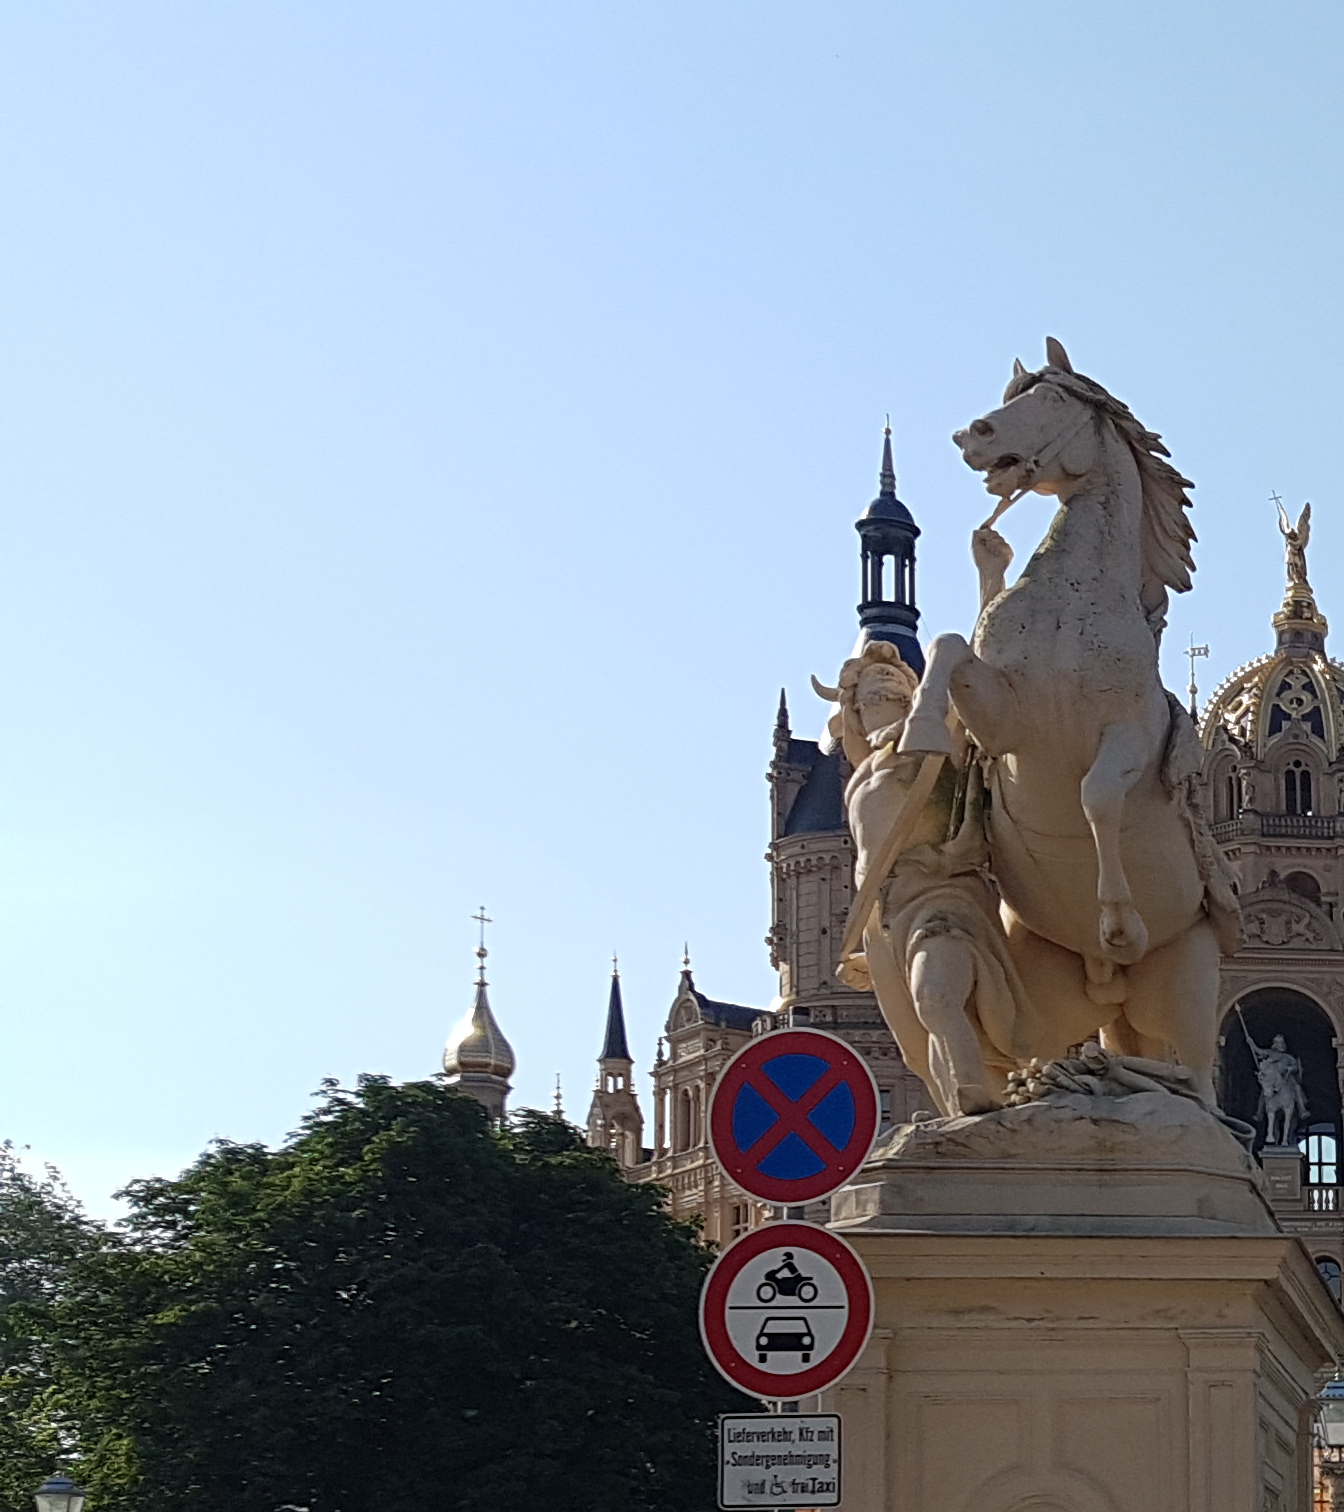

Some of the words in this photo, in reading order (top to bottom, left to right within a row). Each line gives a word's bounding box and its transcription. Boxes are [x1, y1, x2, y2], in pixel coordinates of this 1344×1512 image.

[727, 1427, 795, 1444] Lieferverkehr,
[799, 1427, 814, 1443] Kfz
[817, 1427, 835, 1442] mit
[731, 1451, 831, 1470] Sondergenehmigung
[808, 1477, 836, 1494] Taxi
